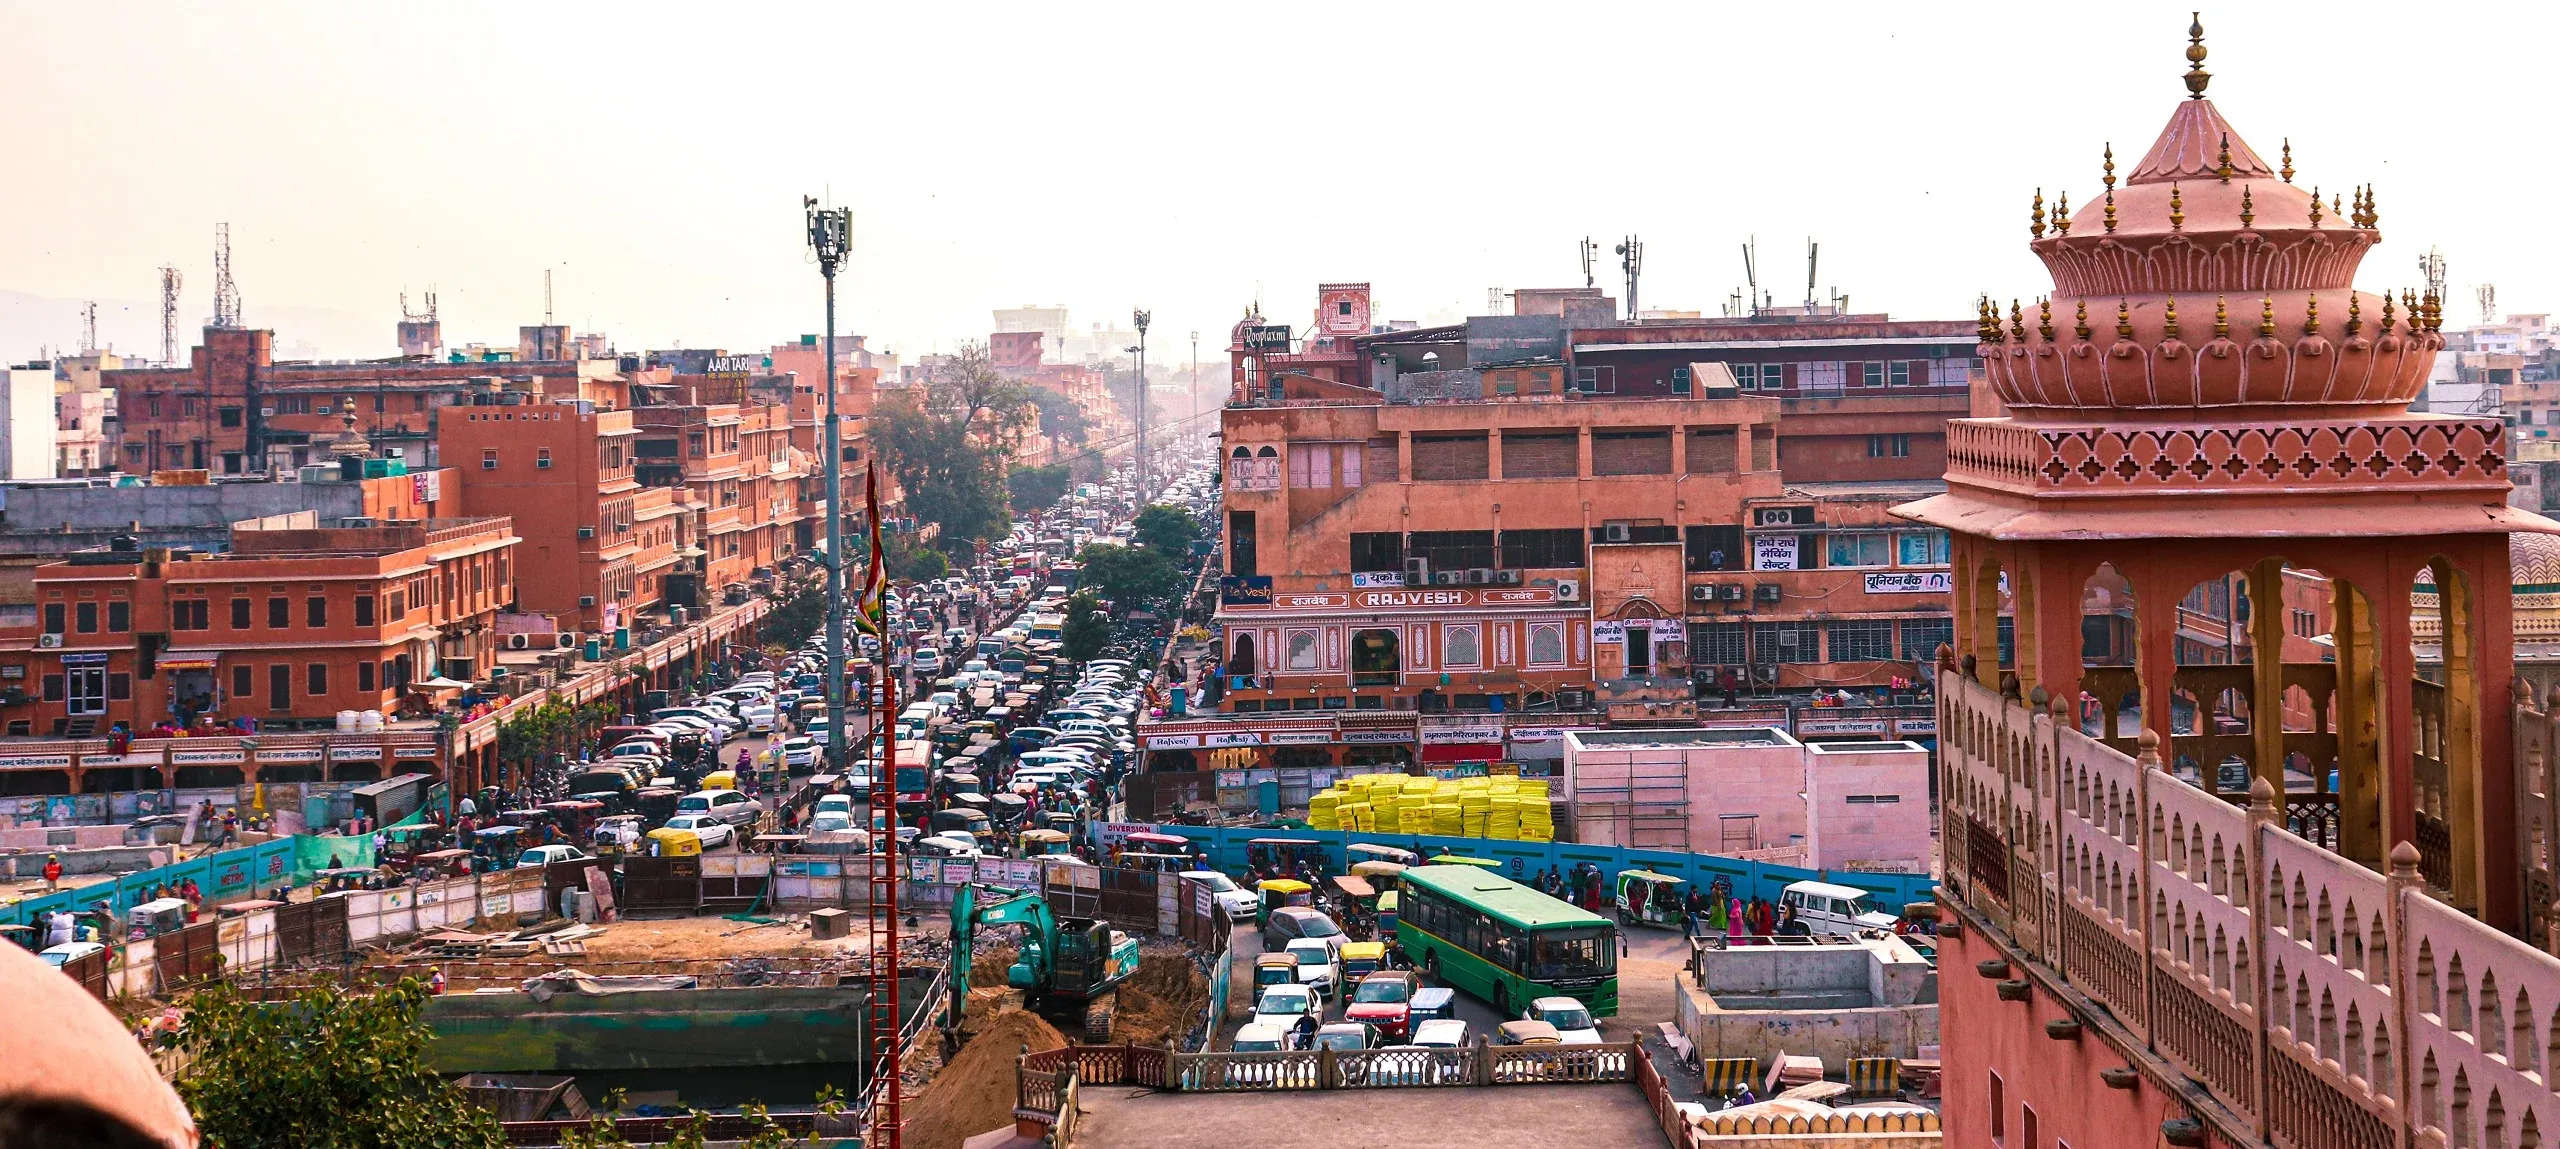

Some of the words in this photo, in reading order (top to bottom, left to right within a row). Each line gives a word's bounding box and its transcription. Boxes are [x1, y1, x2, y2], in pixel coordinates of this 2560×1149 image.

[1244, 326, 1286, 347] Rooplaxmi
[707, 357, 729, 371] AARI
[730, 357, 749, 371] TARI
[1757, 539, 1776, 547] राधे
[1778, 539, 1796, 547] राधे
[1370, 573, 1393, 584] यूको
[1866, 574, 1903, 589] यूनियन
[1903, 573, 1923, 586] बैंक
[1291, 595, 1329, 606] राजवेश
[1367, 592, 1462, 606] RAJVESH
[1655, 626, 1669, 634] Union
[1156, 738, 1189, 746] Rajvesh
[1216, 735, 1249, 744] Rajvesh
[1107, 825, 1151, 833] DIVERSION
